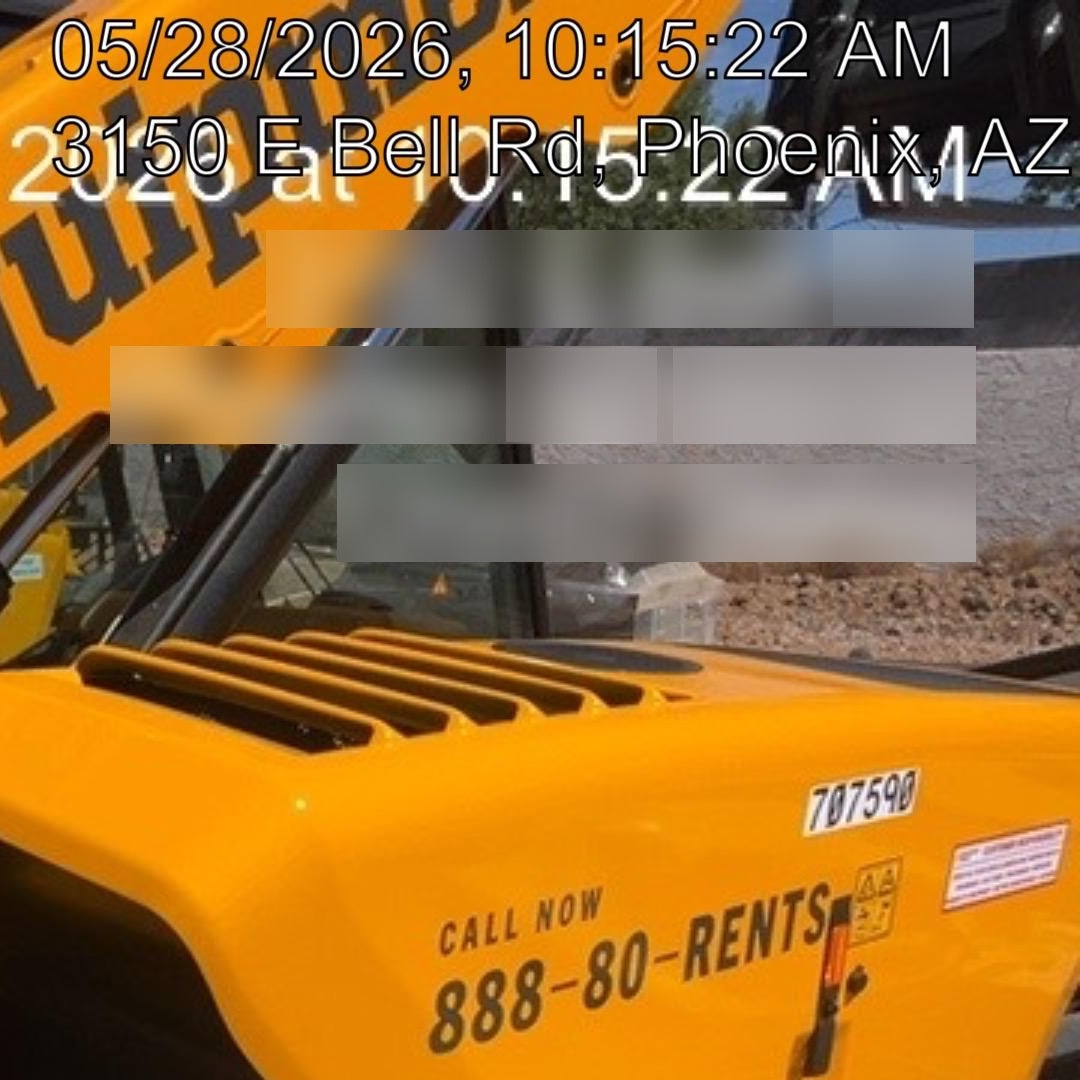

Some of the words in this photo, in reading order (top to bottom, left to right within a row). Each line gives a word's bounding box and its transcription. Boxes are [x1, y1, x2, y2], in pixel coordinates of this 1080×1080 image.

[810, 768, 916, 831] 707590
[439, 907, 518, 957] CALL
[535, 886, 604, 934] NOW
[428, 881, 830, 1055] 888-80-RENTS
